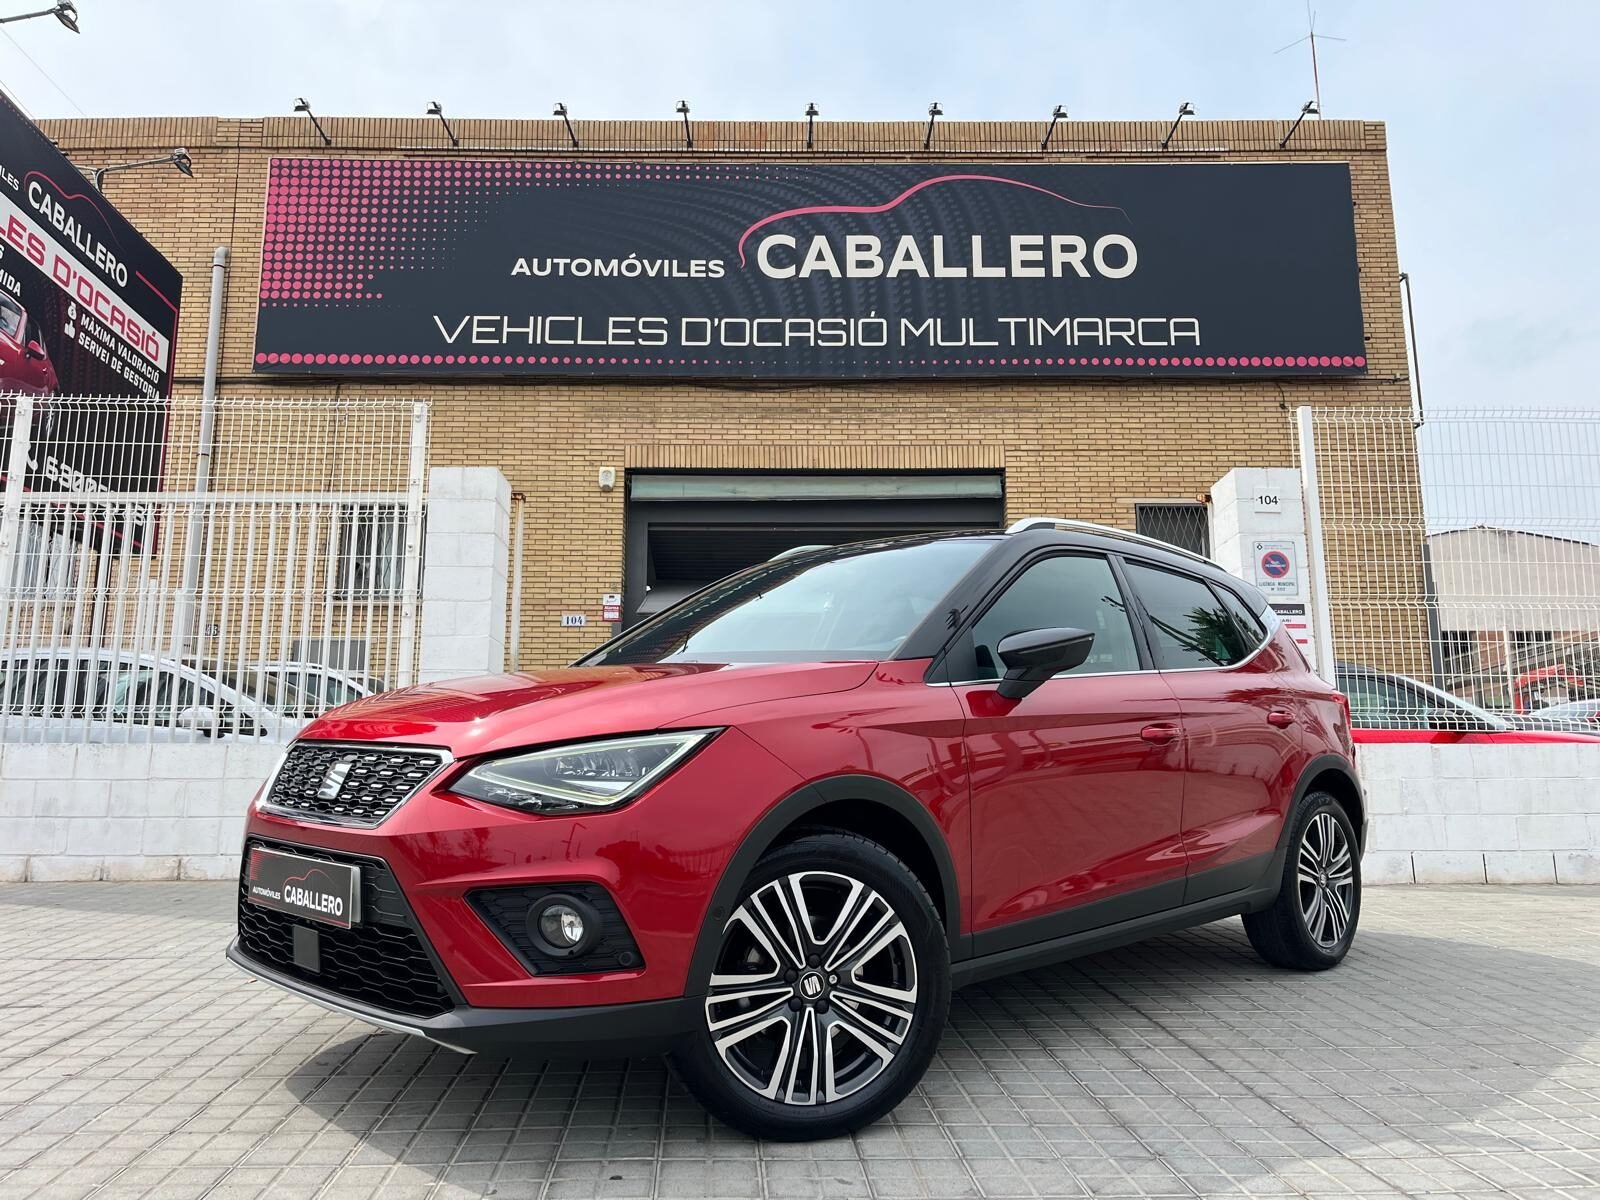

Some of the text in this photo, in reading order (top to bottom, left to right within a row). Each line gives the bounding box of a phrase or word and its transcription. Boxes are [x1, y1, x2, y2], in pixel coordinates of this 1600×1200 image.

[28, 181, 128, 287] CABALLERO
[511, 234, 1138, 279] AUTOMÓVILES CABALLERO
[53, 254, 160, 361] D'OCASIÓ
[433, 311, 1200, 347] VEHICLES D'OCASIÓ MULTIMARCA
[78, 331, 160, 401] SERVEI DE GESTORIA
[117, 342, 160, 384] VALORACIÓ
[1258, 495, 1278, 505] 104
[566, 615, 583, 625] 104
[252, 884, 343, 917] AUTOMÓVILES CABALLERO
